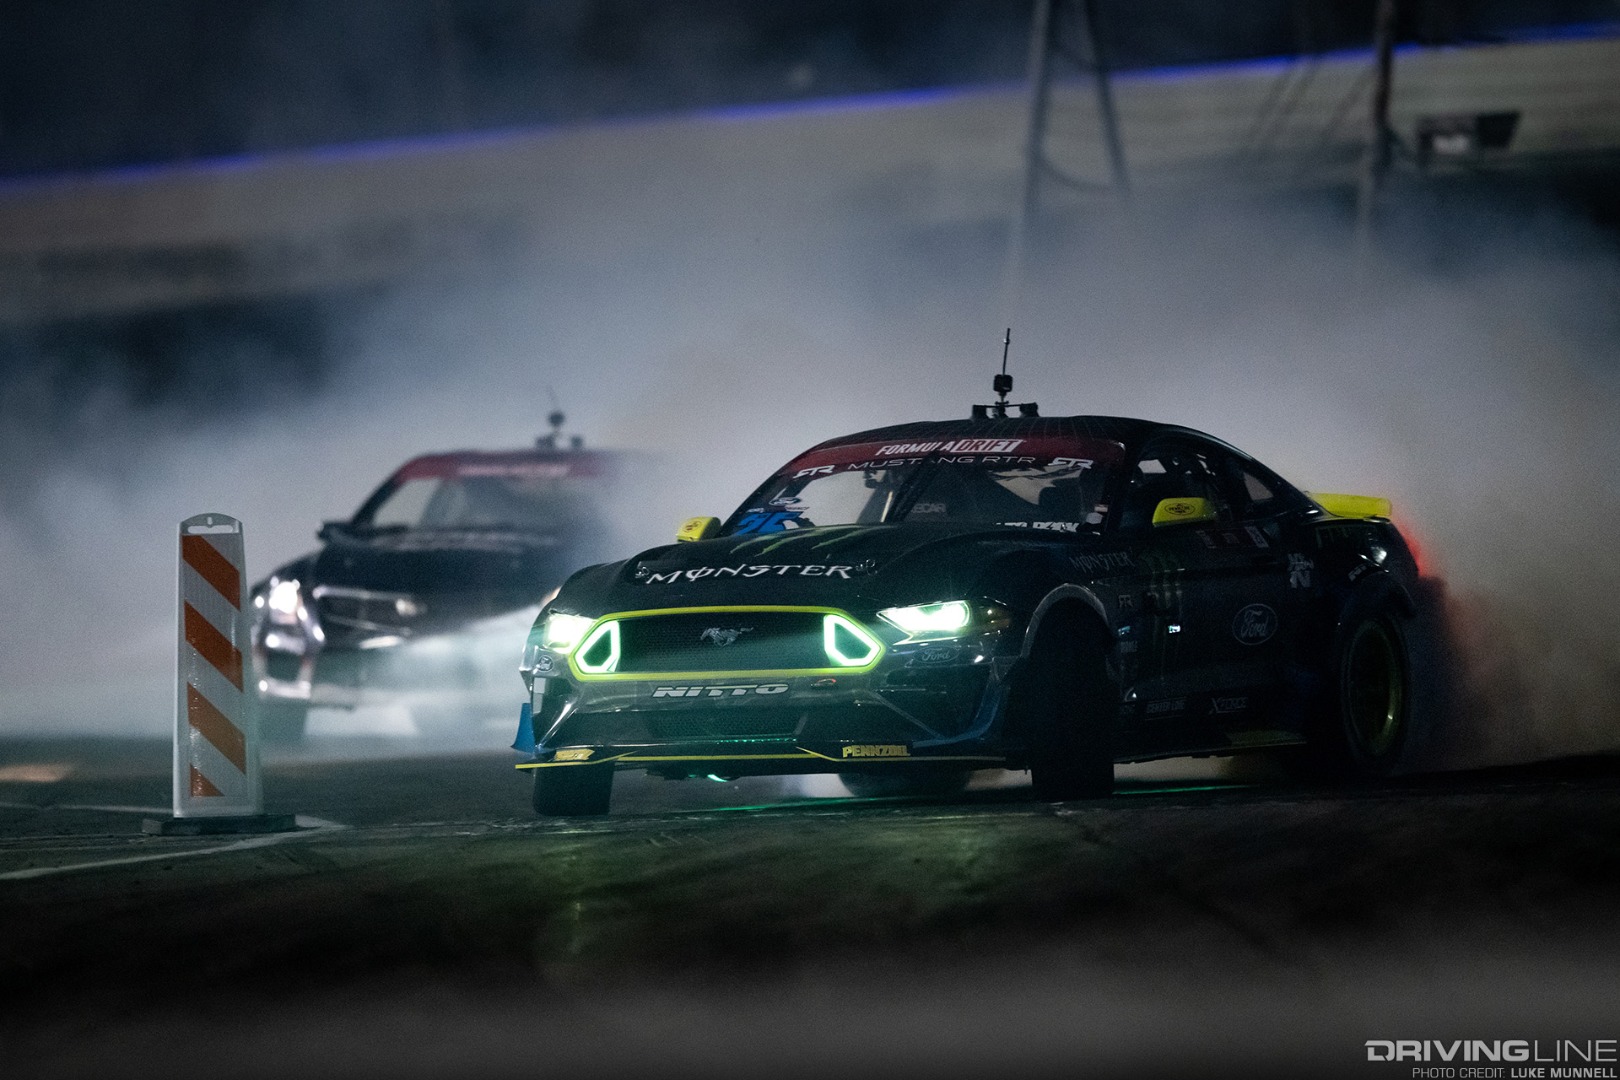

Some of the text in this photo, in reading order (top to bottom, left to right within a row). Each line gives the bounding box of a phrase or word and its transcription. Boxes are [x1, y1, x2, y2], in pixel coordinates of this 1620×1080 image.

[875, 438, 1025, 456] FORMULA DRIFT
[847, 456, 1036, 471] MUSTNG RTR
[652, 683, 789, 698] NITTO
[842, 744, 911, 758] PENNZOIL
